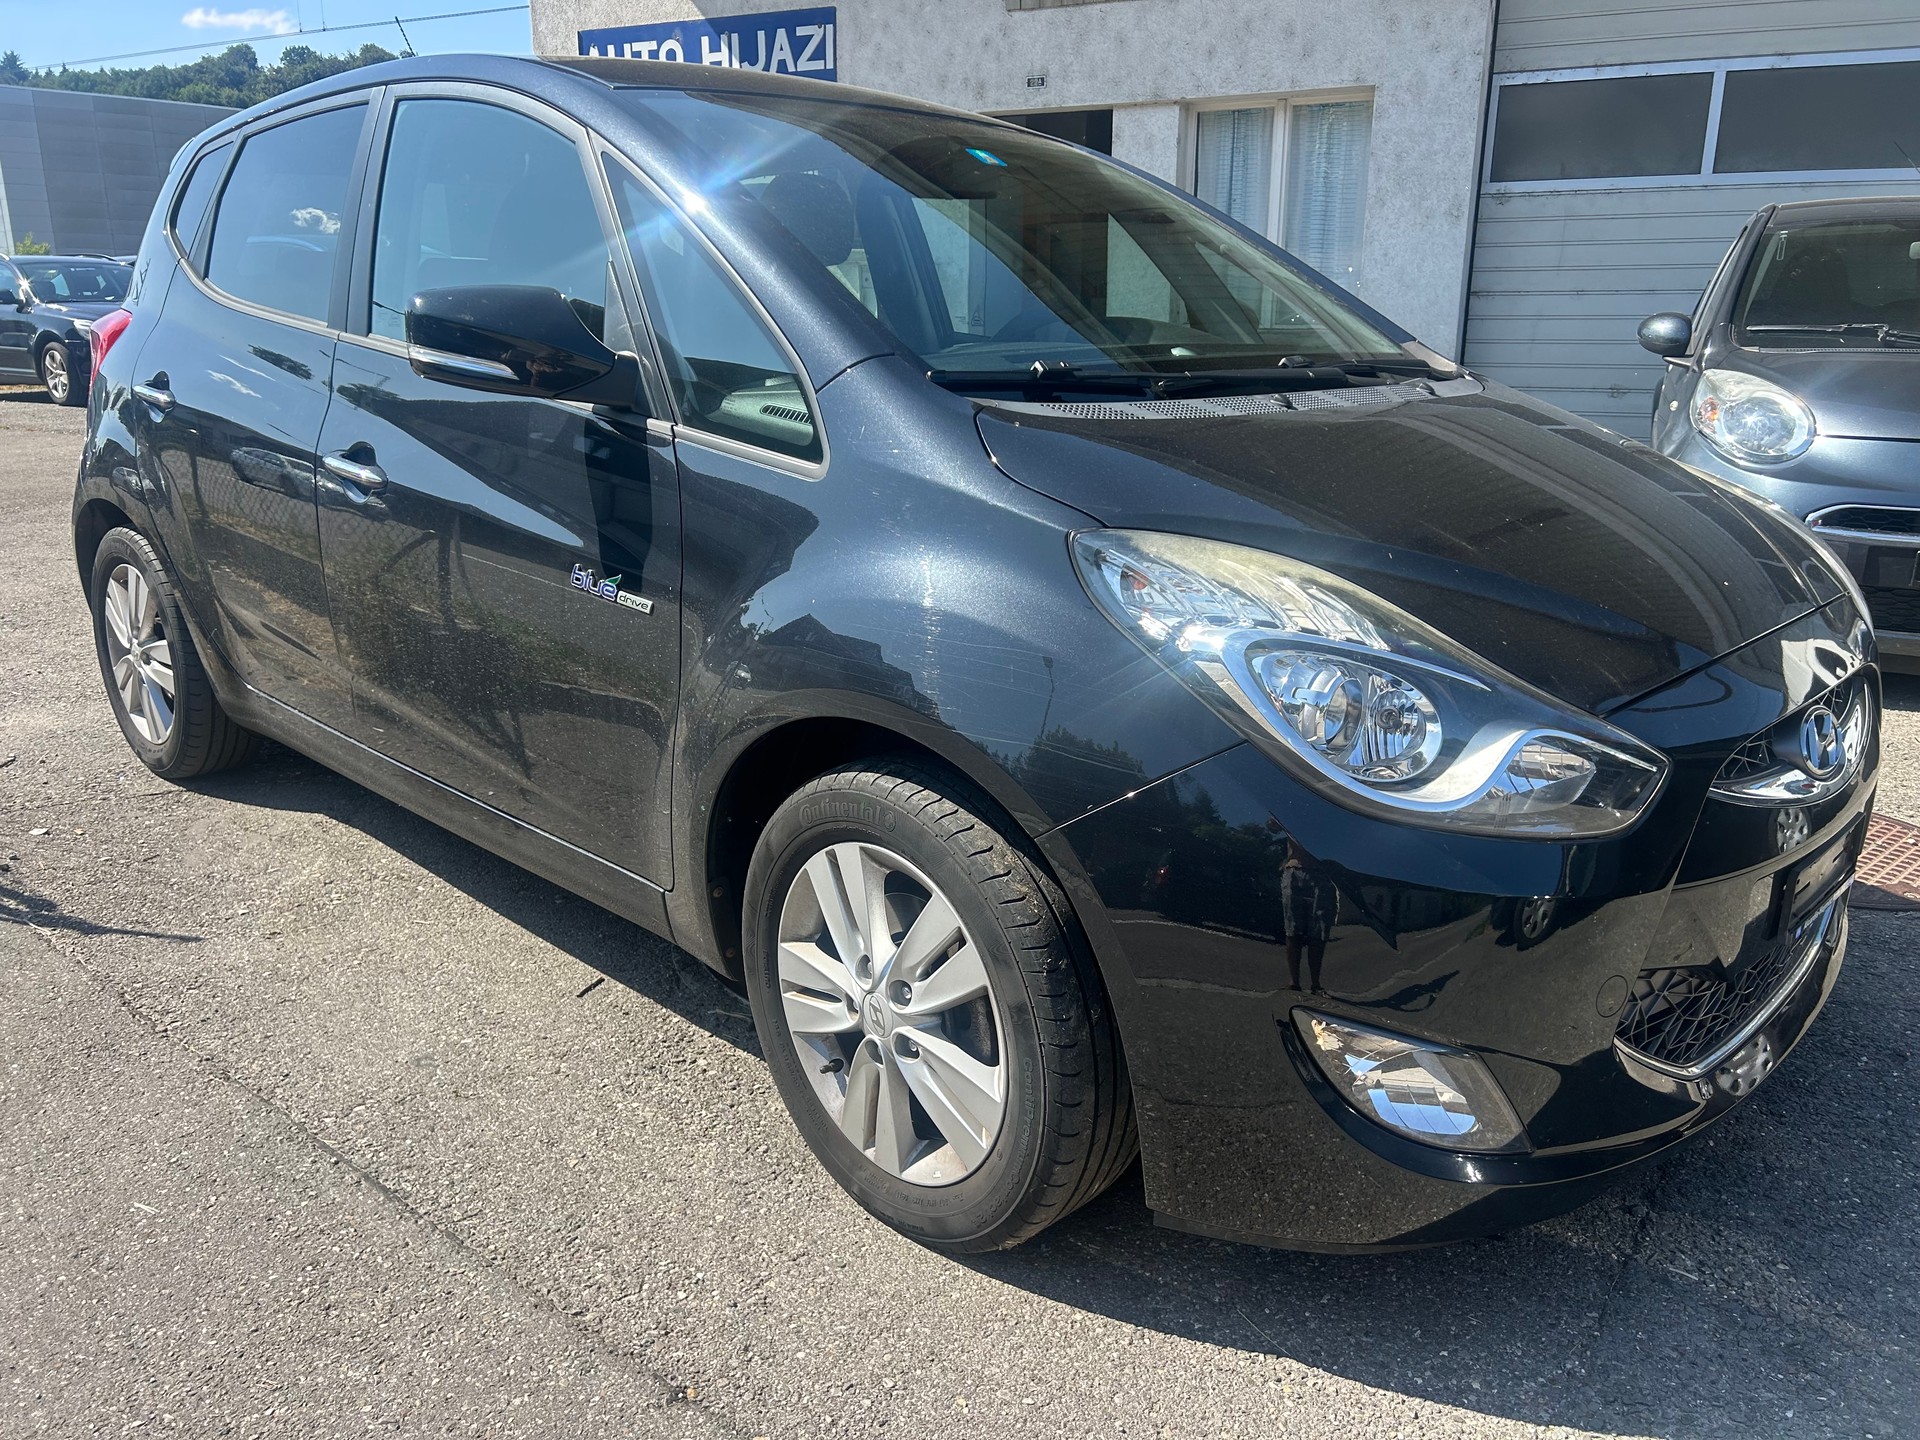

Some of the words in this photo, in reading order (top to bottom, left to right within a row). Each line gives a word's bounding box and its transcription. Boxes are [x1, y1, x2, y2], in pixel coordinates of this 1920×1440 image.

[701, 24, 834, 74] HIJAZI
[571, 563, 617, 601] blue
[618, 594, 649, 611] drive
[800, 798, 881, 826] Continental
